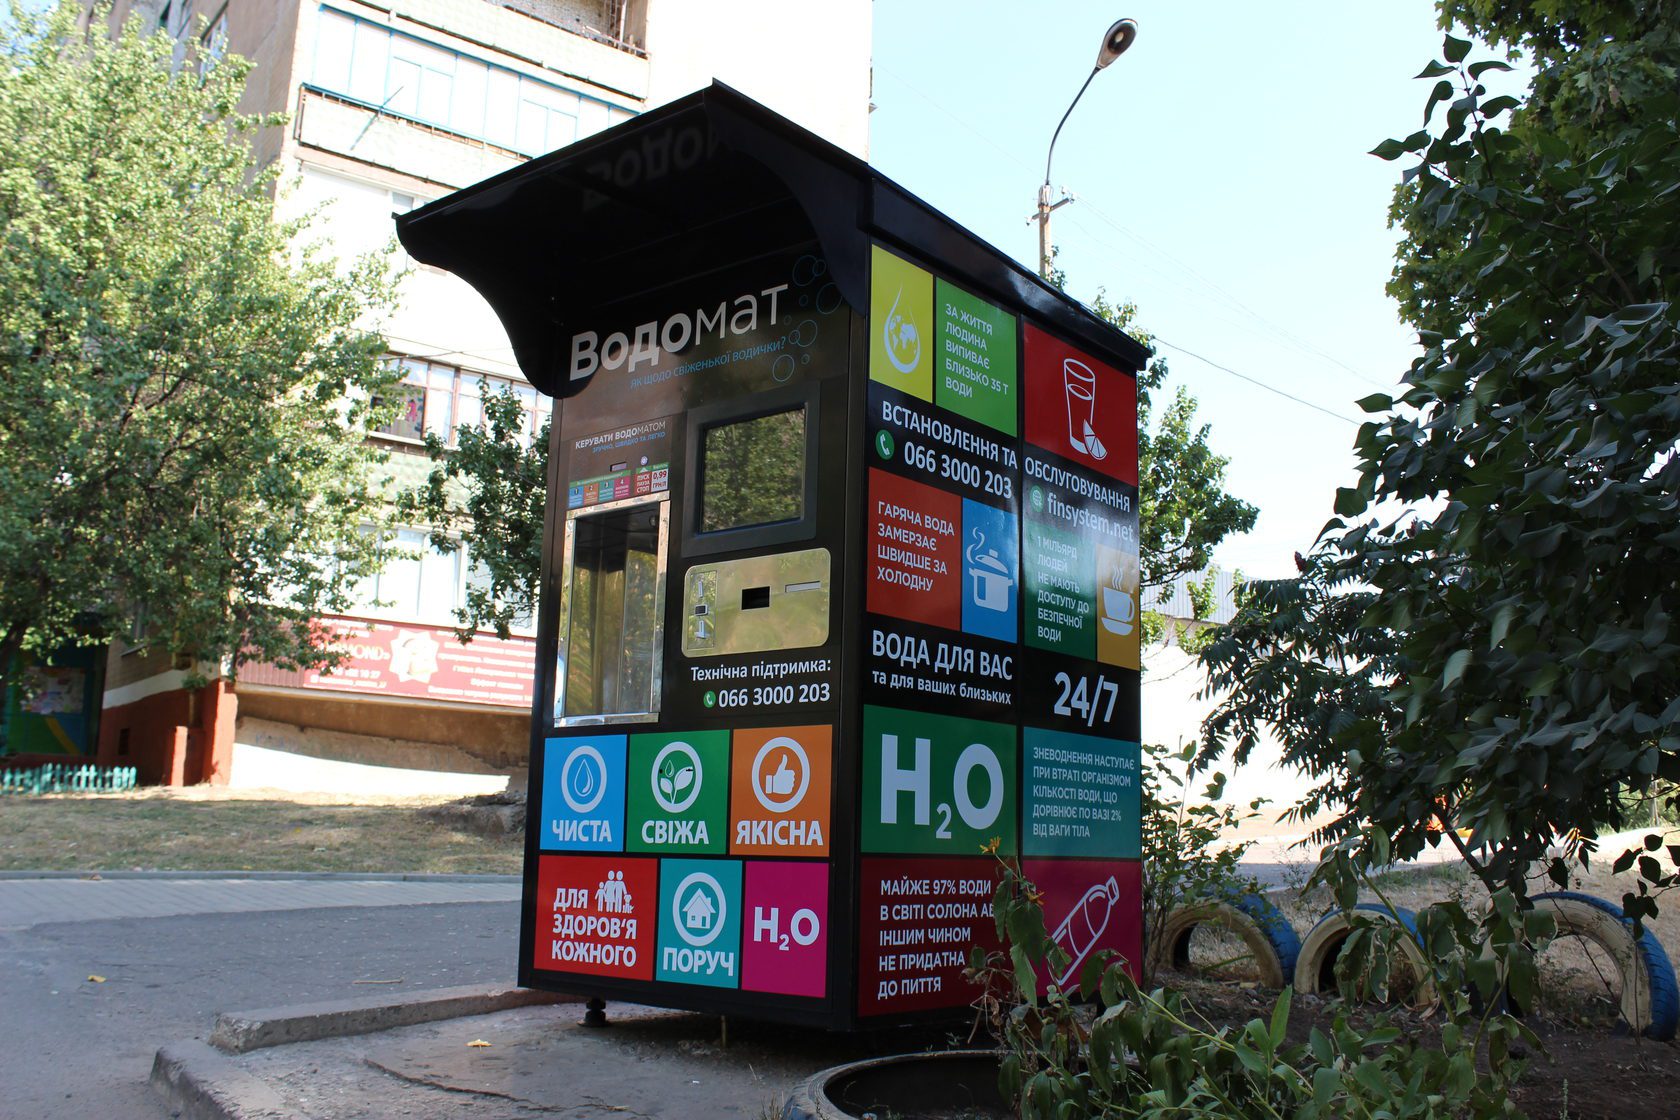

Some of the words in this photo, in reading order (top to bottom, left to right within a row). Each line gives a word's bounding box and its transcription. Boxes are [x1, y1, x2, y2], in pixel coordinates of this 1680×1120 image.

[946, 304, 958, 319] ЗА
[960, 310, 993, 335] ЖИТТЯ
[945, 322, 987, 351] ЛЮДИНА
[732, 337, 786, 362] водички?
[946, 341, 990, 370] ВИПИВАЄ
[946, 358, 989, 387] БЛИЗЬКО
[991, 379, 1001, 393] 35
[946, 377, 973, 398] ВОДИ
[576, 433, 613, 450] КЕРУВАТИ
[615, 421, 666, 440] ВОДОМАТОМ
[883, 401, 999, 462] ВСТАНОВЛЕННЯ
[1002, 447, 1018, 469] ТА
[1025, 456, 1130, 513] ОБСЛУГОВУВАННЯ
[653, 471, 667, 480] 0,99
[904, 441, 937, 473] 066
[941, 454, 980, 488] 3000
[985, 469, 1012, 499] 203
[878, 502, 922, 526] ГАРЯЧА
[925, 513, 955, 536] ВОДА
[1048, 492, 1134, 542] finsystem.net
[878, 523, 937, 551] ЗАМЕРЗАЄ
[1043, 538, 1077, 560] МІЛЬЯРД
[878, 544, 931, 571] ШВИДШЕ
[934, 557, 947, 575] ЗА
[1038, 554, 1068, 573] ЛЮДЕЙ
[878, 566, 933, 592] ХОЛОДНУ
[1037, 572, 1049, 585] НЕ
[1051, 576, 1080, 594] МАЮТЬ
[1038, 590, 1075, 611] ДОСТУПУ
[1077, 599, 1089, 614] ДО
[1038, 608, 1082, 630] БЕЗПЕЧНОЇ
[1038, 626, 1062, 642] ВОДИ
[873, 630, 931, 669] ВОДА
[935, 643, 974, 676] ДЛЯ
[980, 652, 1013, 681] ВАС
[691, 664, 748, 682] Технічна
[752, 659, 831, 679] підтримка:
[719, 689, 748, 708] 066
[753, 686, 794, 706] 3000
[799, 683, 830, 703] 203
[873, 670, 886, 685] та
[890, 674, 914, 690] для
[918, 679, 956, 697] ваших
[960, 683, 1011, 705] близьких
[1054, 672, 1119, 727] 24/7
[1033, 747, 1093, 766] ЗНЕВОДНЕННЯ
[1095, 756, 1135, 770] НАСТУПАЄ
[1033, 766, 1050, 780] ПРИ
[1052, 768, 1080, 782] ВТРАТІ
[1082, 772, 1131, 787] ОРГАНІЗМОМ
[1033, 785, 1076, 801] КІЛЬКОСТІ
[1078, 789, 1102, 804] ВОДИ,
[1103, 792, 1118, 805] ЩО
[1033, 804, 1077, 819] ДОРІВНЮЄ
[1079, 806, 1090, 819] ПО
[1092, 807, 1109, 821] ВАЗІ
[1111, 810, 1122, 822] 2%
[552, 820, 612, 842] ЧИСТА
[641, 820, 709, 845] СВІЖА
[736, 821, 824, 846] ЯКІСНА
[1033, 823, 1048, 838] ВІД
[1049, 824, 1071, 837] ВАГИ
[1072, 825, 1090, 838] ТІЛА
[881, 876, 930, 896] МАЙЖЕ
[933, 880, 956, 896] 97%
[959, 880, 991, 897] ВОДИ
[554, 888, 588, 912] ДЛЯ
[880, 905, 889, 921] В
[892, 904, 924, 920] СВІТІ
[927, 903, 978, 920] СОЛОНА
[880, 929, 925, 947] ІНШИМ
[928, 927, 971, 944] ЧИНОМ
[552, 940, 637, 968] КОЖНОГО
[663, 947, 734, 976] ПОРУЧ
[879, 954, 896, 972] НЕ
[899, 950, 966, 971] ПРИДАТНА
[878, 981, 898, 1000] ДО
[901, 976, 941, 995] ПИТТЯ
